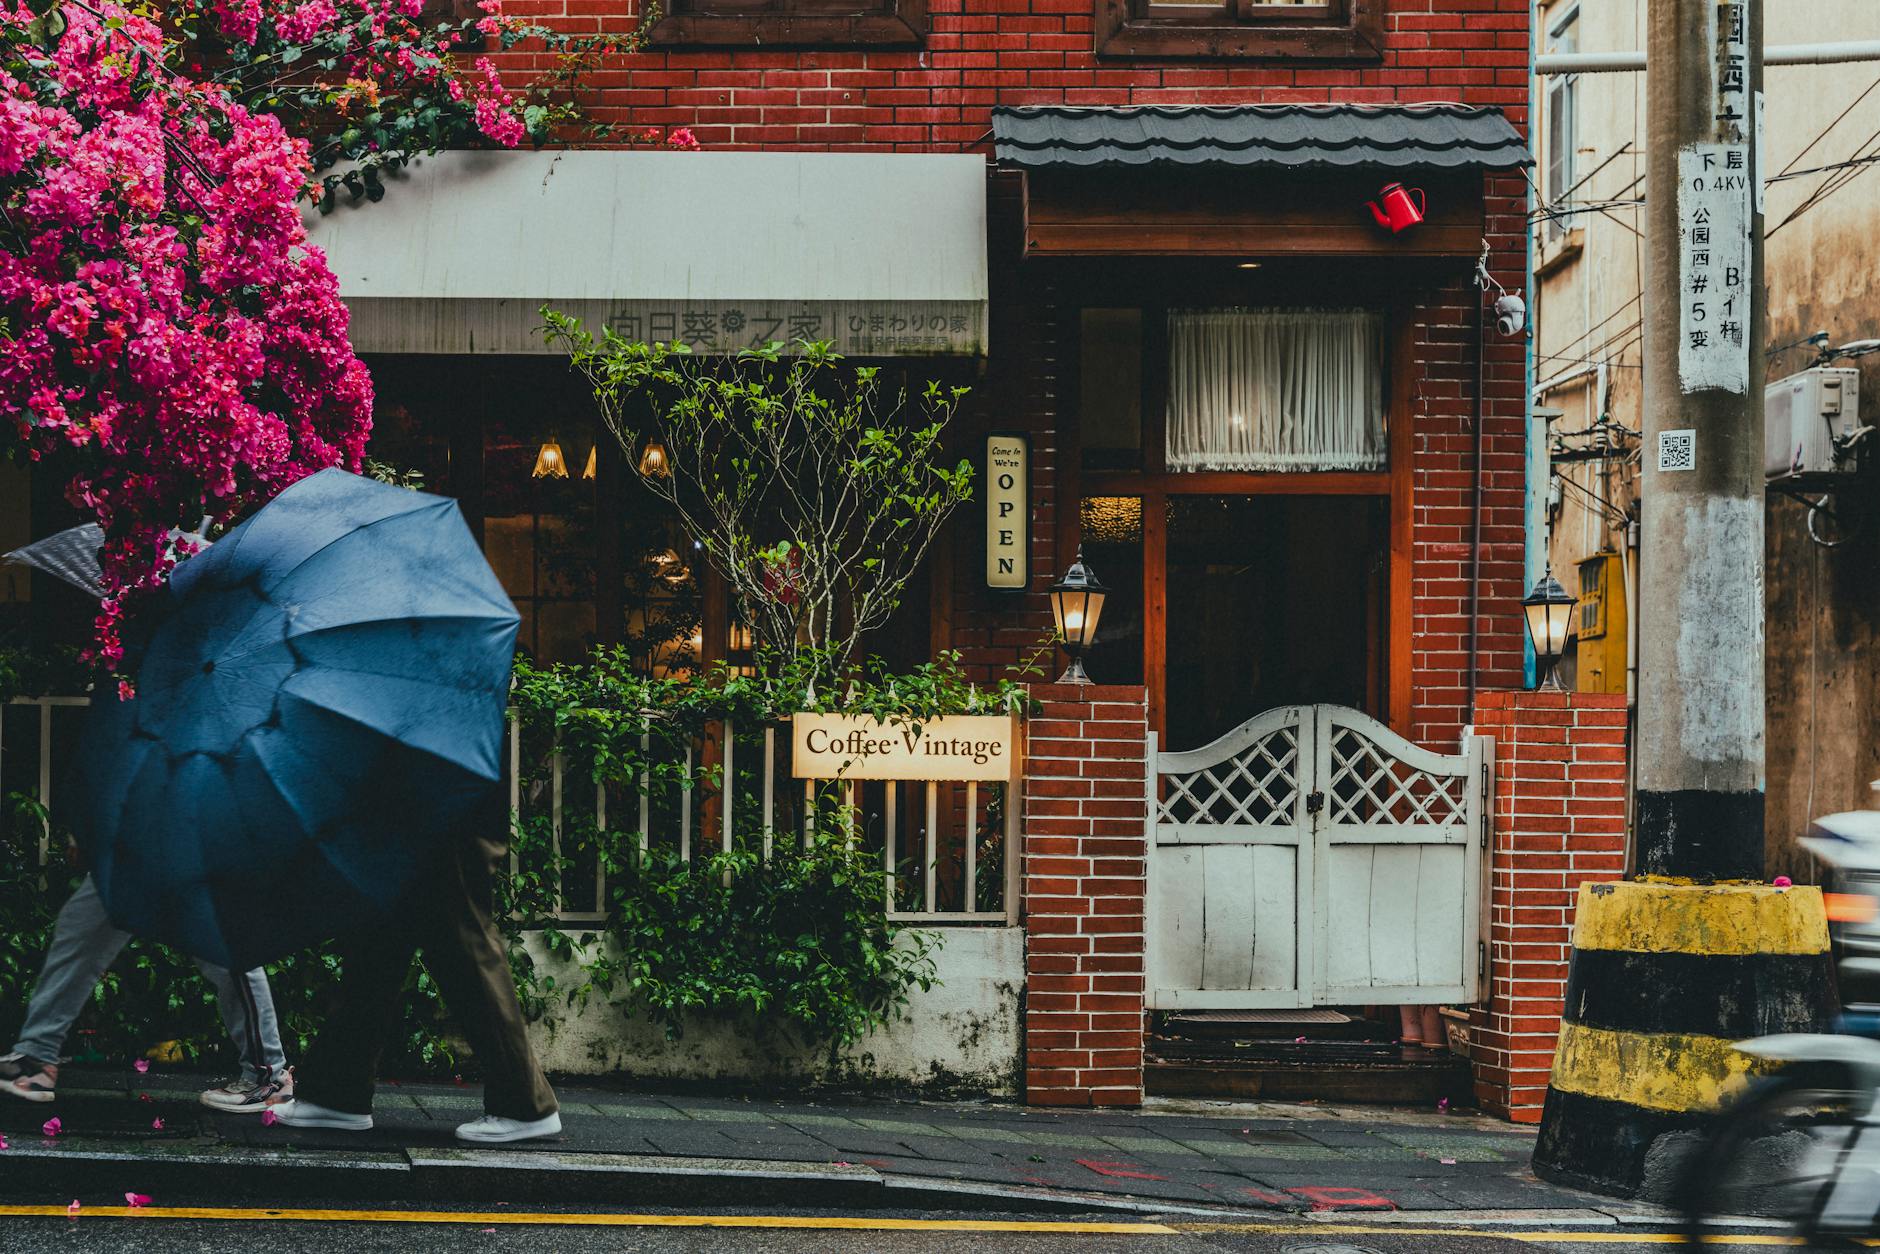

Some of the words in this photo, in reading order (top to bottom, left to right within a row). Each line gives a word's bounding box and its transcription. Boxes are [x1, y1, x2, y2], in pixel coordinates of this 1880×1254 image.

[1701, 151, 1743, 172] 下层
[1693, 175, 1745, 192] 0.4KV
[848, 314, 968, 333] ひまわりの家
[992, 446, 1011, 456] Come
[1013, 447, 1021, 455] In
[994, 459, 1019, 467] We're
[998, 473, 1014, 574] OPEN
